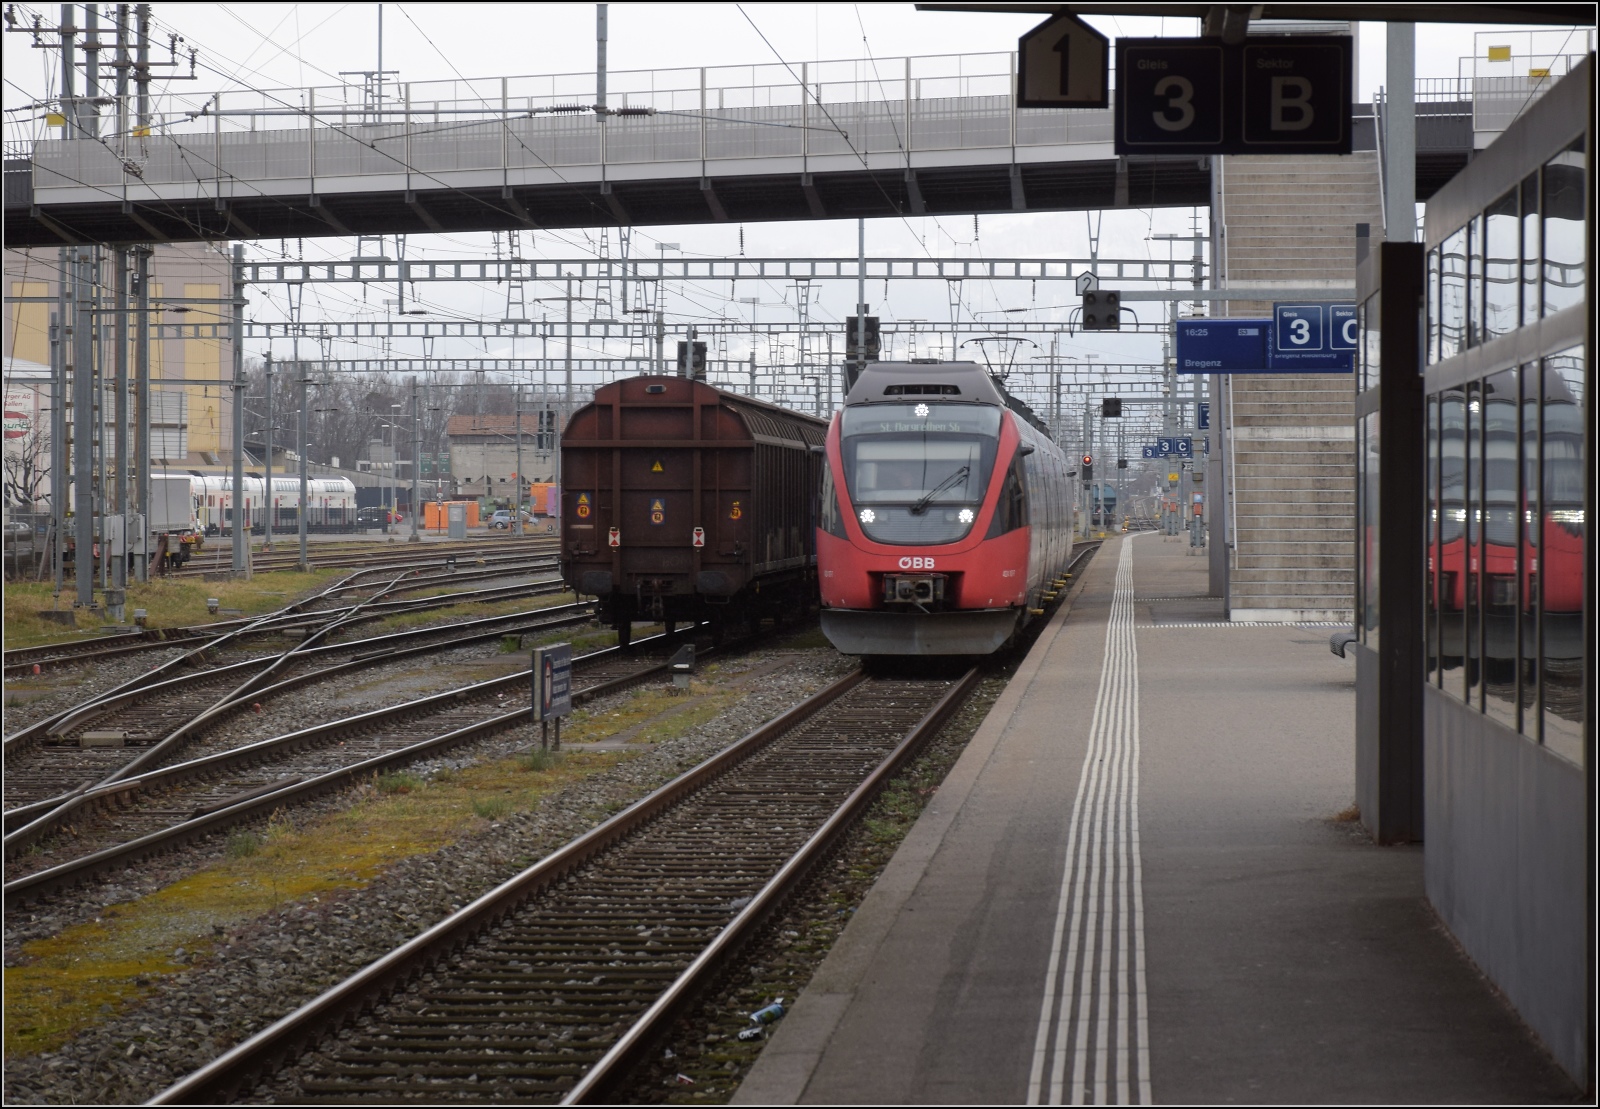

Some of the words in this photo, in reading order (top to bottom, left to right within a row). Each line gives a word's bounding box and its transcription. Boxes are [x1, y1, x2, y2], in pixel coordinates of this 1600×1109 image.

[1052, 34, 1069, 95] 1
[1137, 59, 1169, 70] Gleis
[1256, 58, 1294, 69] Sektor
[1152, 75, 1195, 131] 3
[1270, 76, 1314, 130] B
[1083, 277, 1092, 291] 2
[1185, 328, 1209, 336] 16:25
[1289, 318, 1310, 345] 3
[1185, 359, 1222, 369] Bregenz
[1162, 442, 1170, 451] 3
[1178, 442, 1186, 451] C
[898, 556, 935, 569] ÖBB
